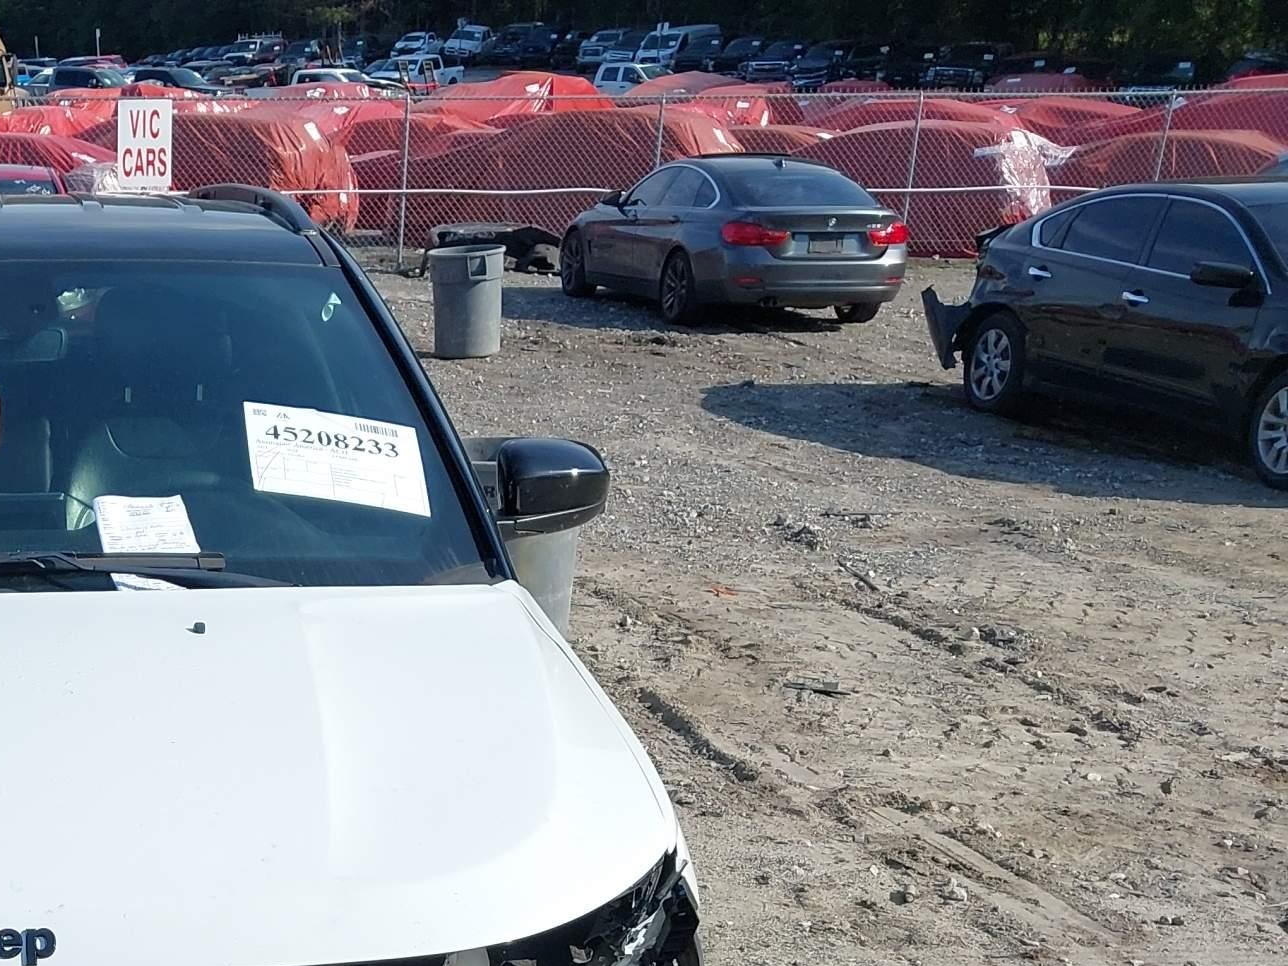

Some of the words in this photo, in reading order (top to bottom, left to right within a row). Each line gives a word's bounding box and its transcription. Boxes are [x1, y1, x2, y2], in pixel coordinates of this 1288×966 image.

[129, 109, 160, 139] VIC
[122, 147, 167, 178] CARS
[265, 424, 400, 458] 45208233
